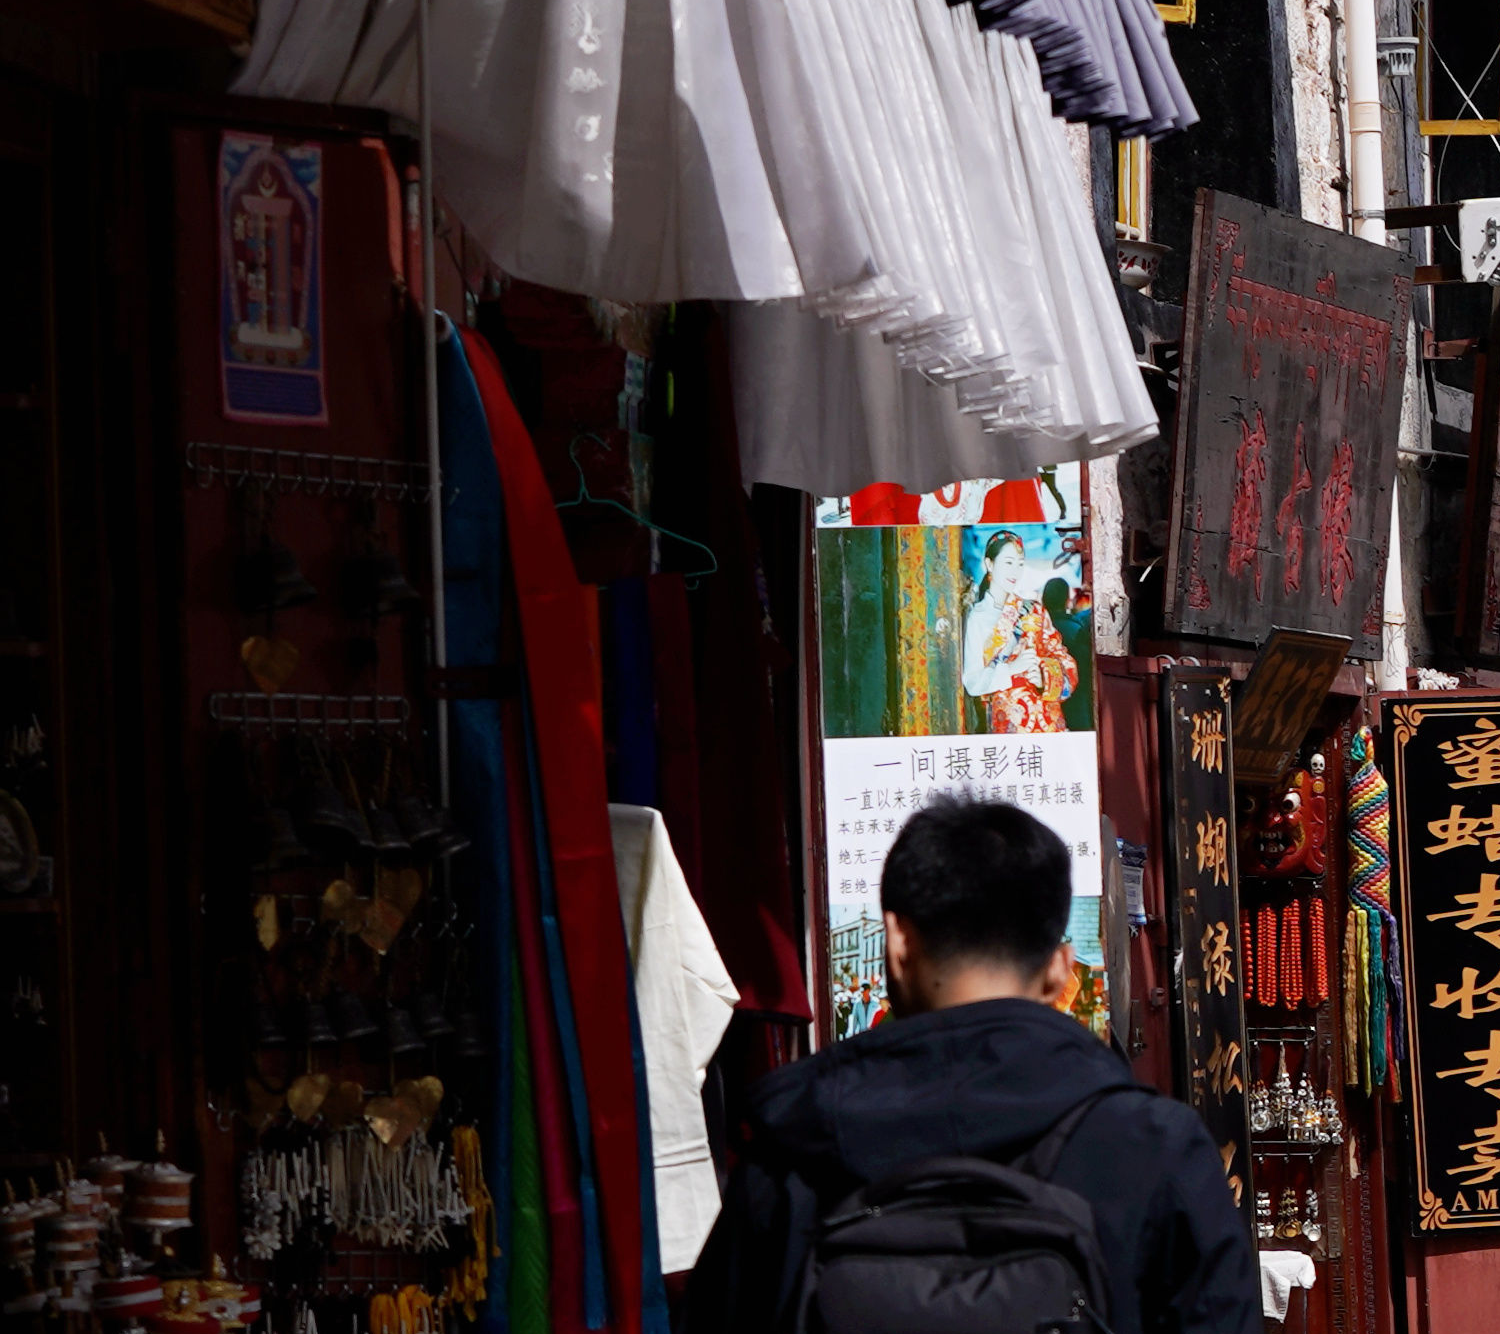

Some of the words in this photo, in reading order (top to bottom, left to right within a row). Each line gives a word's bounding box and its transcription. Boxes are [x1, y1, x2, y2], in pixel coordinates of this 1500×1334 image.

[873, 743, 1045, 782] 一间摄影铺
